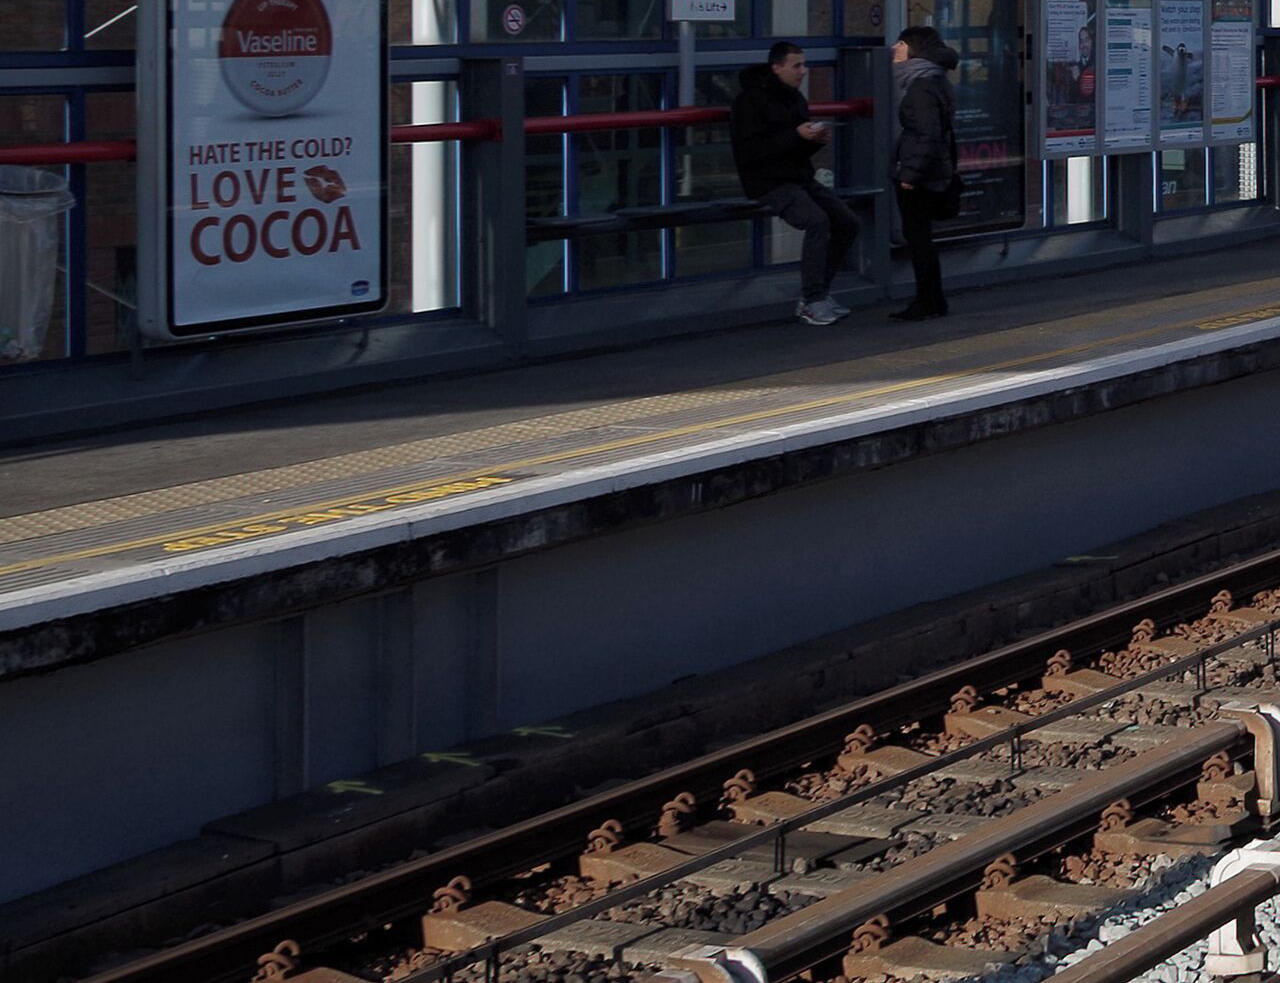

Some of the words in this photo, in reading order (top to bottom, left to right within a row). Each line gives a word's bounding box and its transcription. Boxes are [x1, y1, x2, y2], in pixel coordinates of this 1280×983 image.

[705, 2, 719, 12] Lift
[237, 29, 317, 53] Vaseline
[250, 80, 275, 97] COCOA
[277, 79, 304, 97] BUTTER
[189, 143, 240, 165] HATE
[245, 140, 285, 162] THE
[291, 136, 353, 159] COLD?
[190, 166, 296, 210] LOVE
[189, 205, 361, 266] COCOA
[384, 476, 513, 504] MIND
[279, 502, 397, 525] THE
[163, 522, 288, 552] STEP
